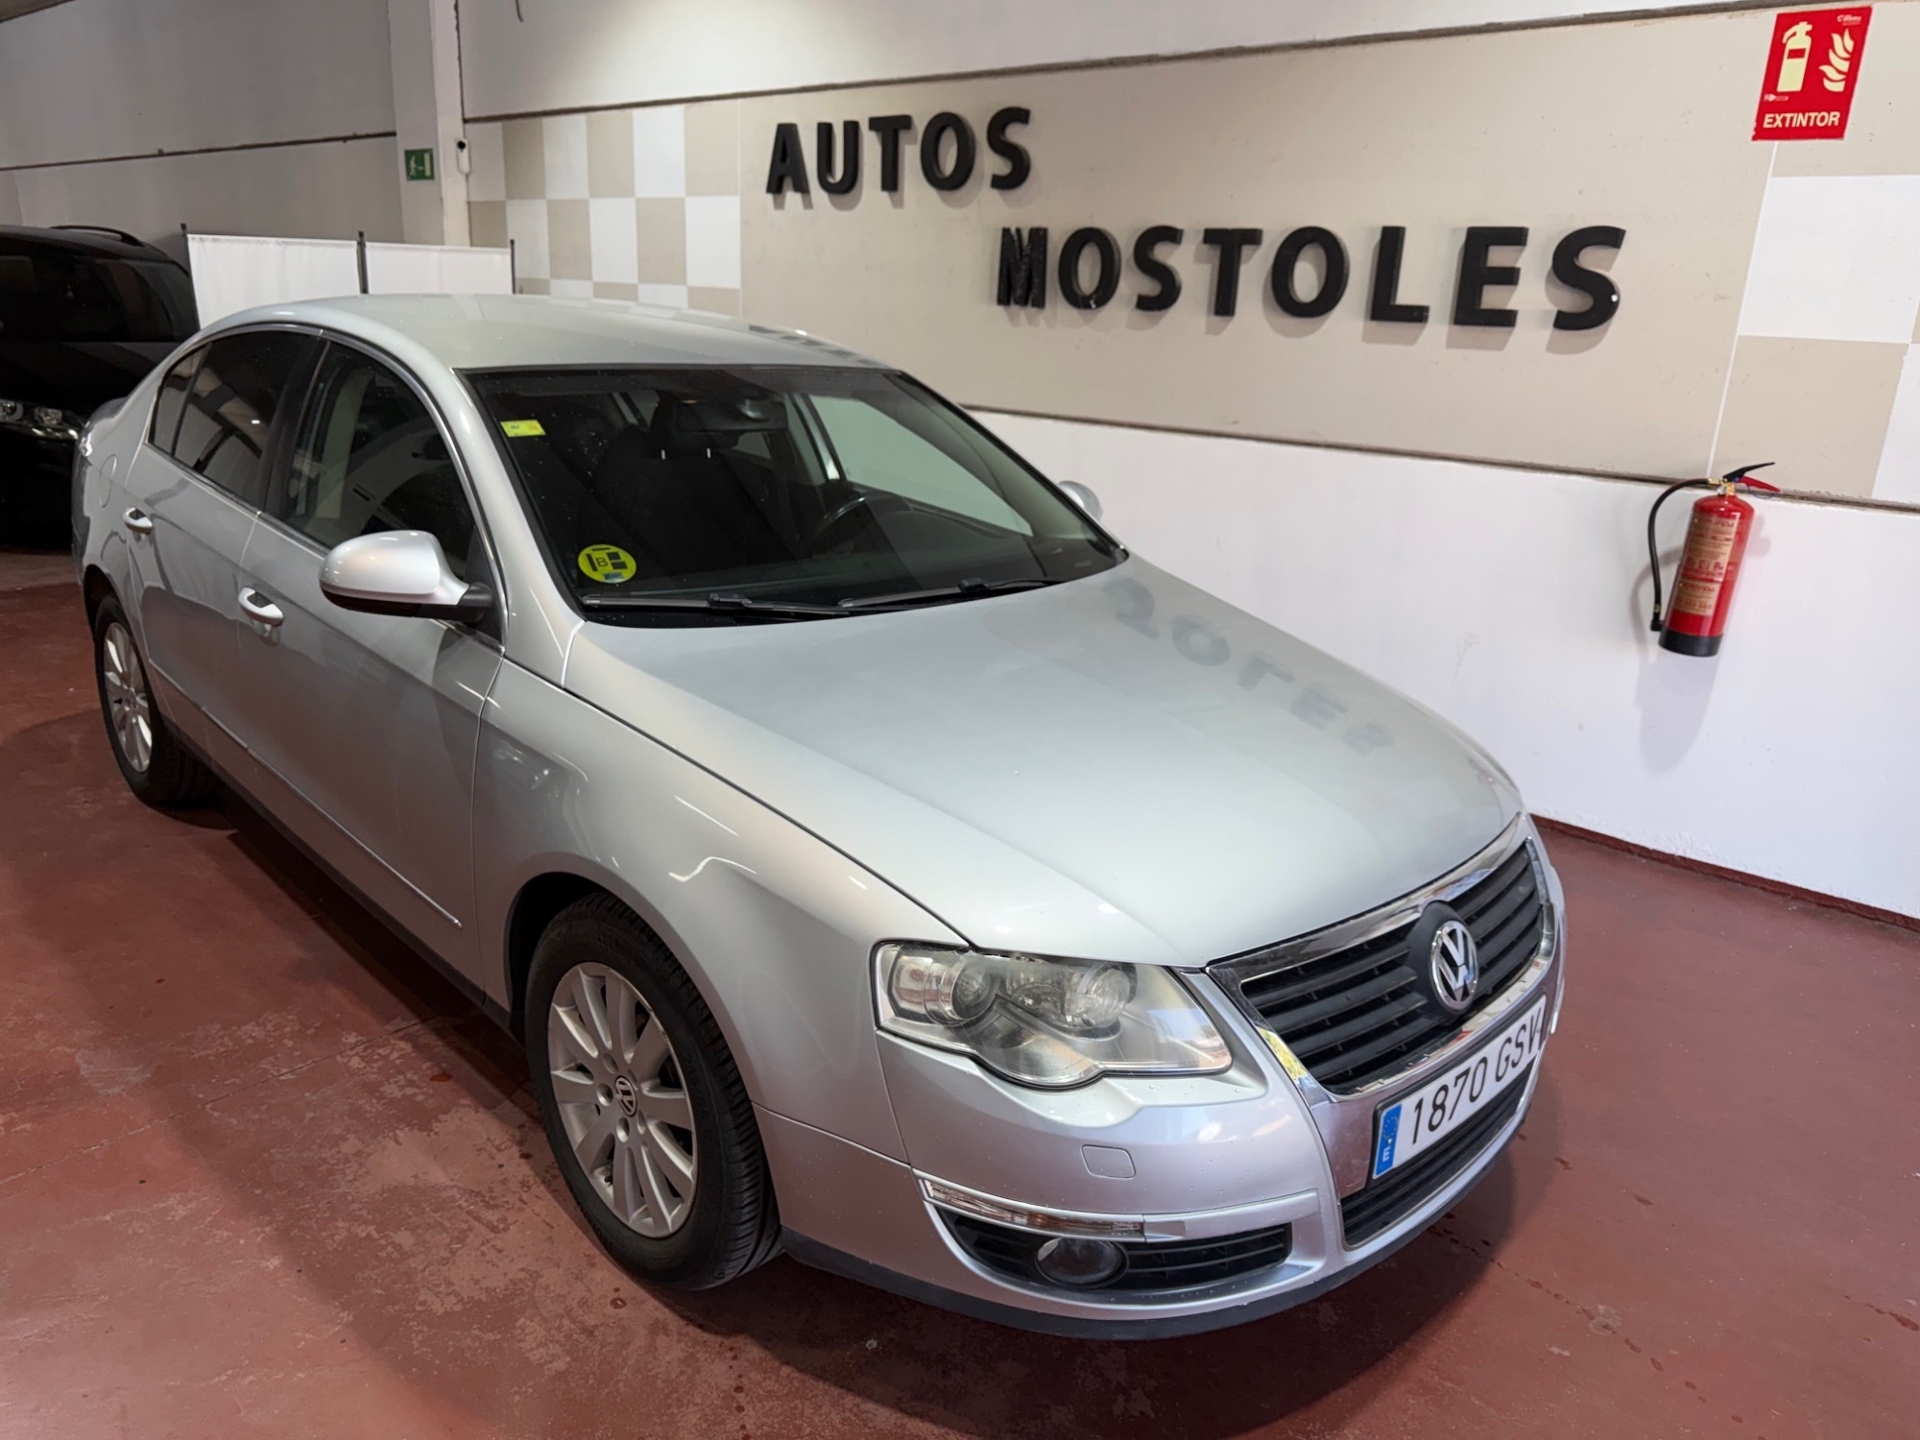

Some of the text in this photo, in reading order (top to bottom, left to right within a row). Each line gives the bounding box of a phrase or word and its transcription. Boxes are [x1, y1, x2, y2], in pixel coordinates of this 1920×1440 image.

[766, 106, 1032, 195] AUTOS
[1762, 110, 1841, 129] EXTINTOR
[997, 225, 1628, 332] MOSTOLES
[595, 557, 608, 567] B
[1411, 1055, 1489, 1145] 1870
